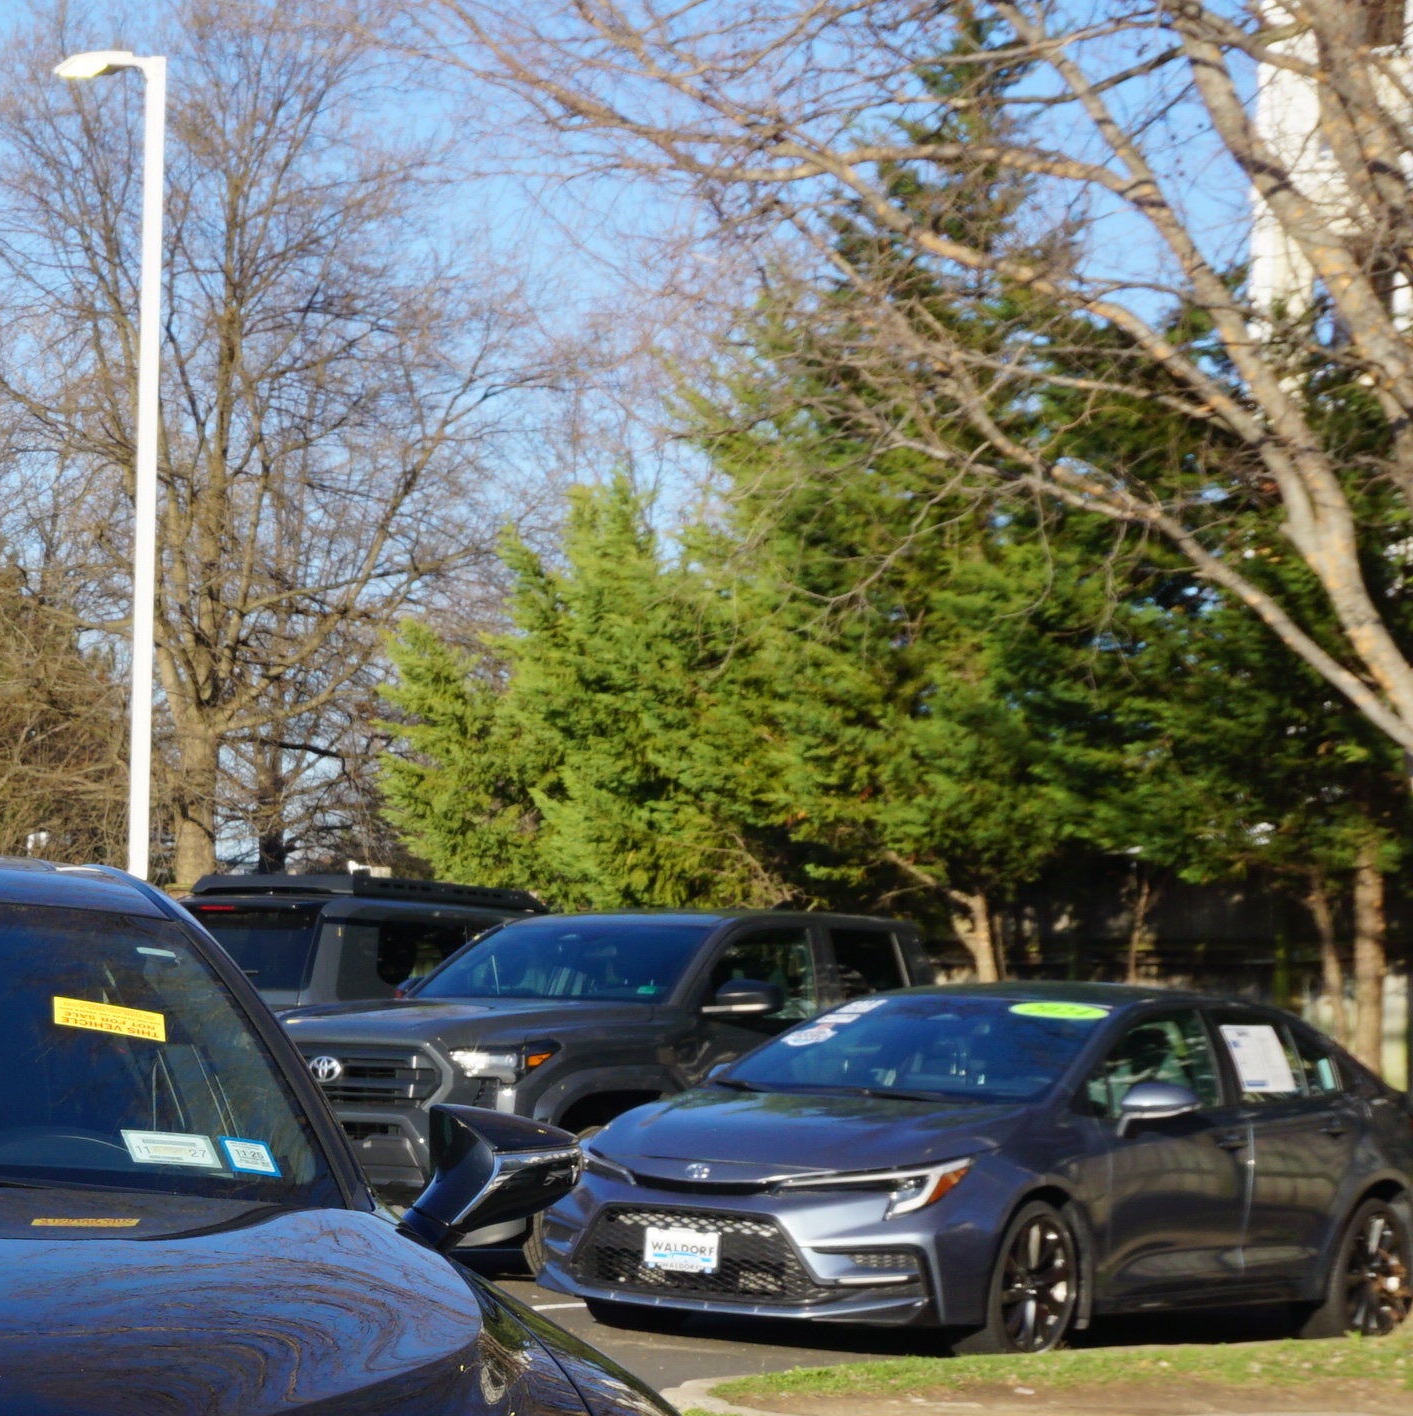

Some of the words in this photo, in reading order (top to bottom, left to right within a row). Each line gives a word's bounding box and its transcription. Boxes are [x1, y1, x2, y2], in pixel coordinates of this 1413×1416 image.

[65, 1011, 96, 1020] SALE
[101, 1017, 126, 1025] FOR
[62, 1016, 122, 1032] VEHICLE
[132, 1022, 156, 1030] NOT
[127, 1027, 160, 1039] THIS
[136, 1145, 151, 1154] 11
[188, 1149, 207, 1158] 27
[651, 1241, 715, 1256] WALDORF
